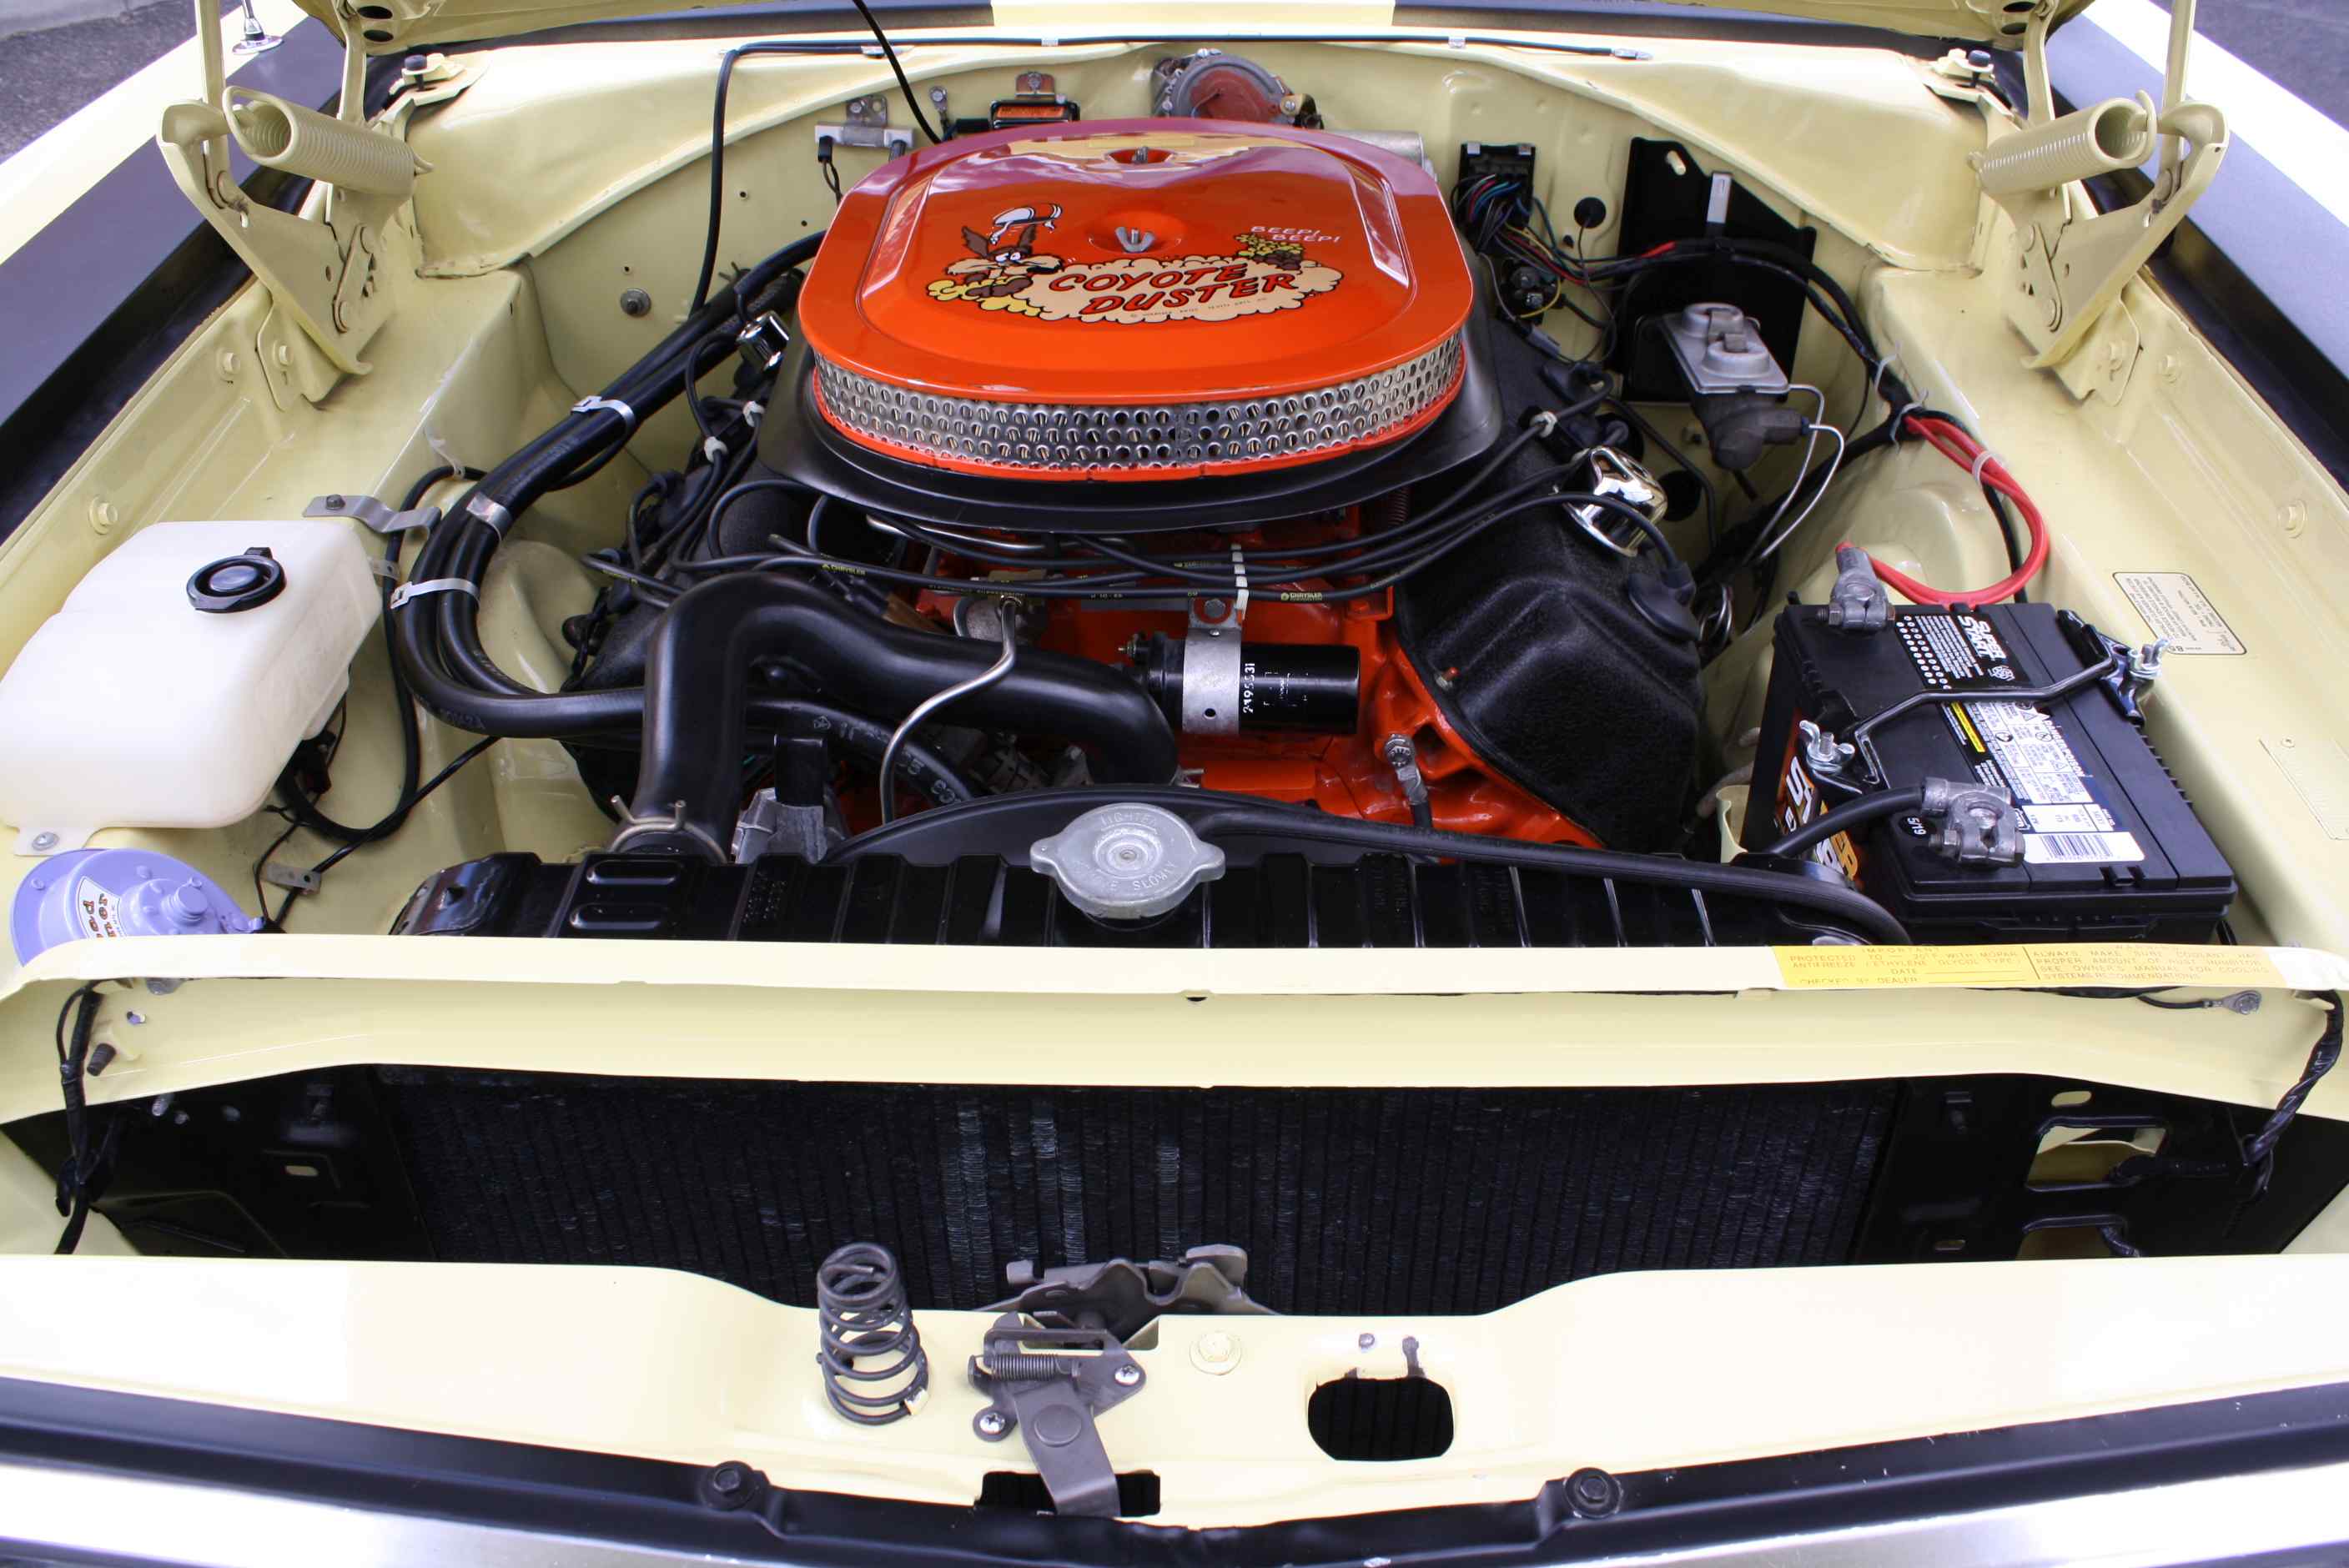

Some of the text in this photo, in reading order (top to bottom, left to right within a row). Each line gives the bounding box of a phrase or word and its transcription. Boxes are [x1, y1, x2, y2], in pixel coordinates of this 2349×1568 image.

[1250, 225, 1321, 235] BEEP!
[1271, 234, 1341, 243] BEEP!
[1049, 263, 1248, 292] COYOTE
[1079, 274, 1299, 315] DUSTER
[1957, 616, 1995, 660] START
[1978, 620, 2007, 660] SUPER
[2043, 720, 2069, 748] DANGER
[2061, 749, 2086, 777] POISON
[1789, 953, 1857, 962] PROTECTED
[1979, 950, 2019, 958] MOPAR
